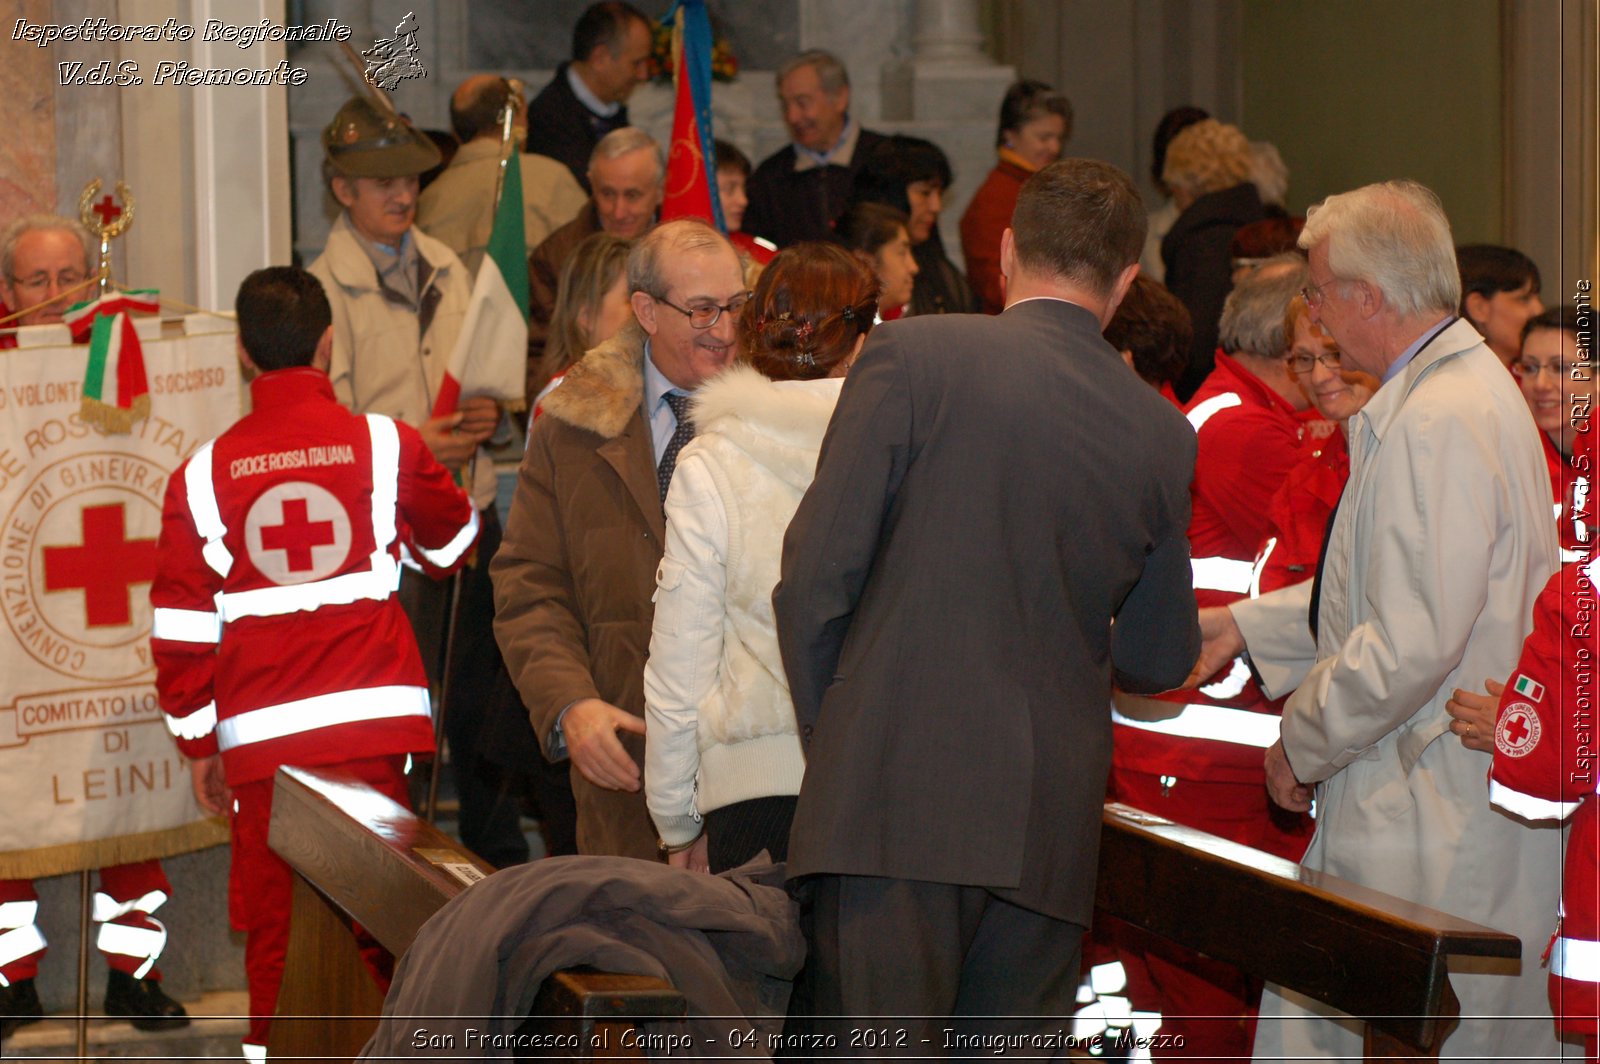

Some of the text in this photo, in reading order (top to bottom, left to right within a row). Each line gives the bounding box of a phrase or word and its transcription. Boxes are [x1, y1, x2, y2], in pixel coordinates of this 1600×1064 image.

[13, 381, 82, 407] VOLONT
[154, 367, 225, 395] SOCCORSO
[230, 444, 355, 480] CROCE ROSSA ITALIANA
[3, 458, 164, 671] CONVENZIONE DI GINEVRA
[23, 693, 158, 726] COMITATO LO
[103, 730, 129, 753] DI
